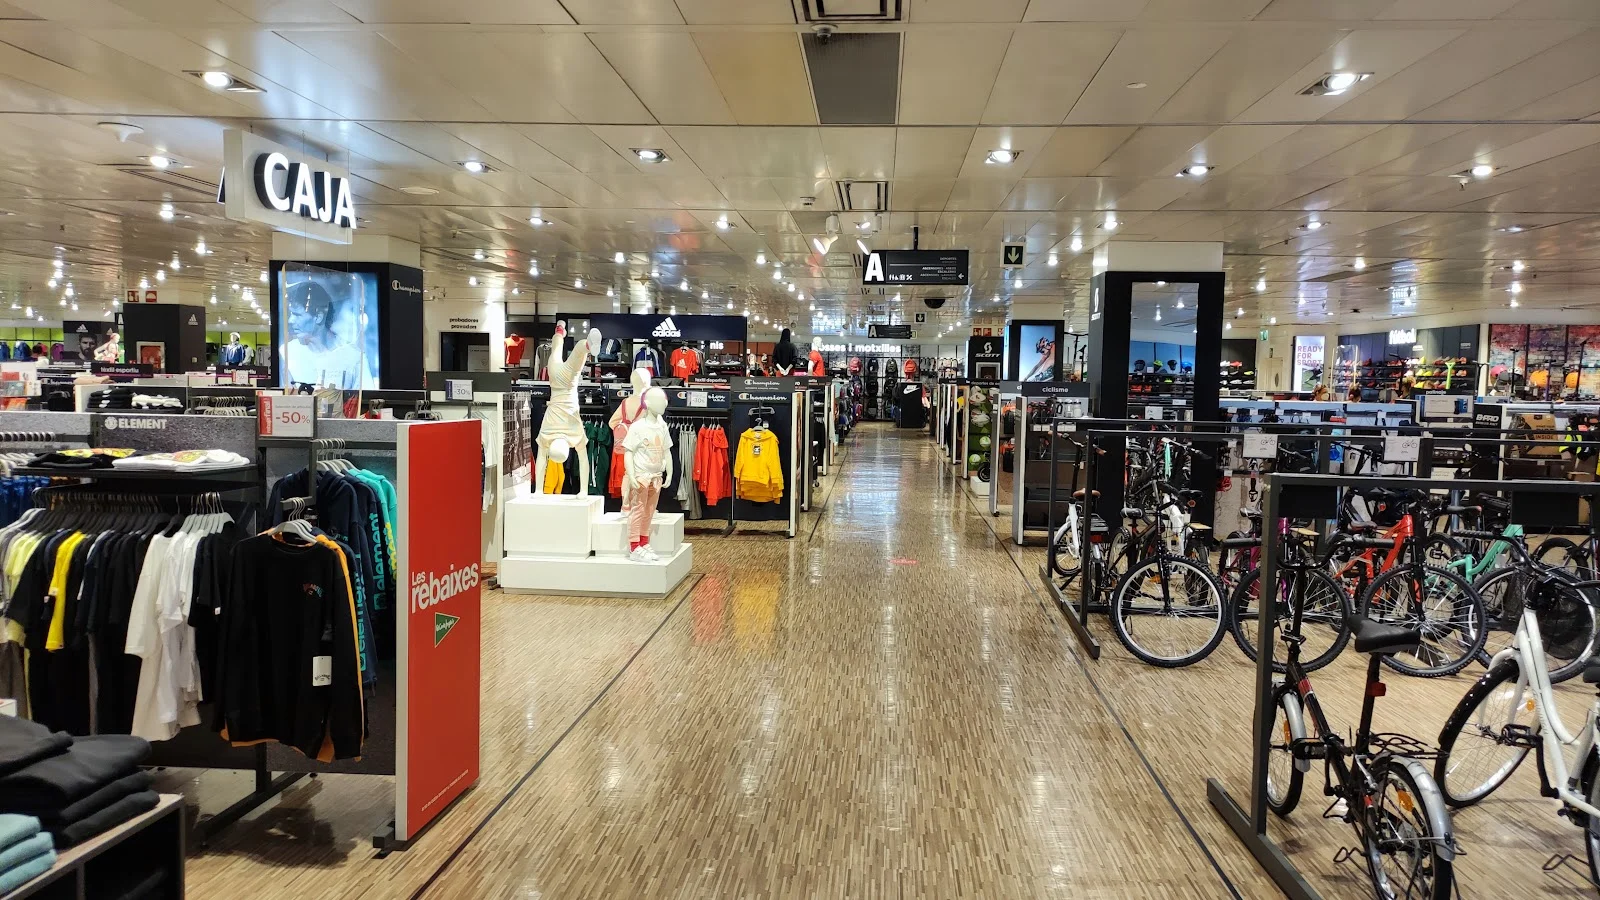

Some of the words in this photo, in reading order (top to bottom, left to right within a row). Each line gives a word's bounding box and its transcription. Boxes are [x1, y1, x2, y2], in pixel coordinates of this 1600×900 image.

[257, 152, 357, 229] CAJA
[864, 253, 884, 281] A
[652, 329, 681, 337] adidas
[869, 326, 877, 337] A
[118, 418, 167, 429] ELEMENT
[276, 411, 311, 424] -50%
[369, 512, 385, 591] element
[412, 571, 426, 586] Les
[412, 563, 479, 614] rebaixes
